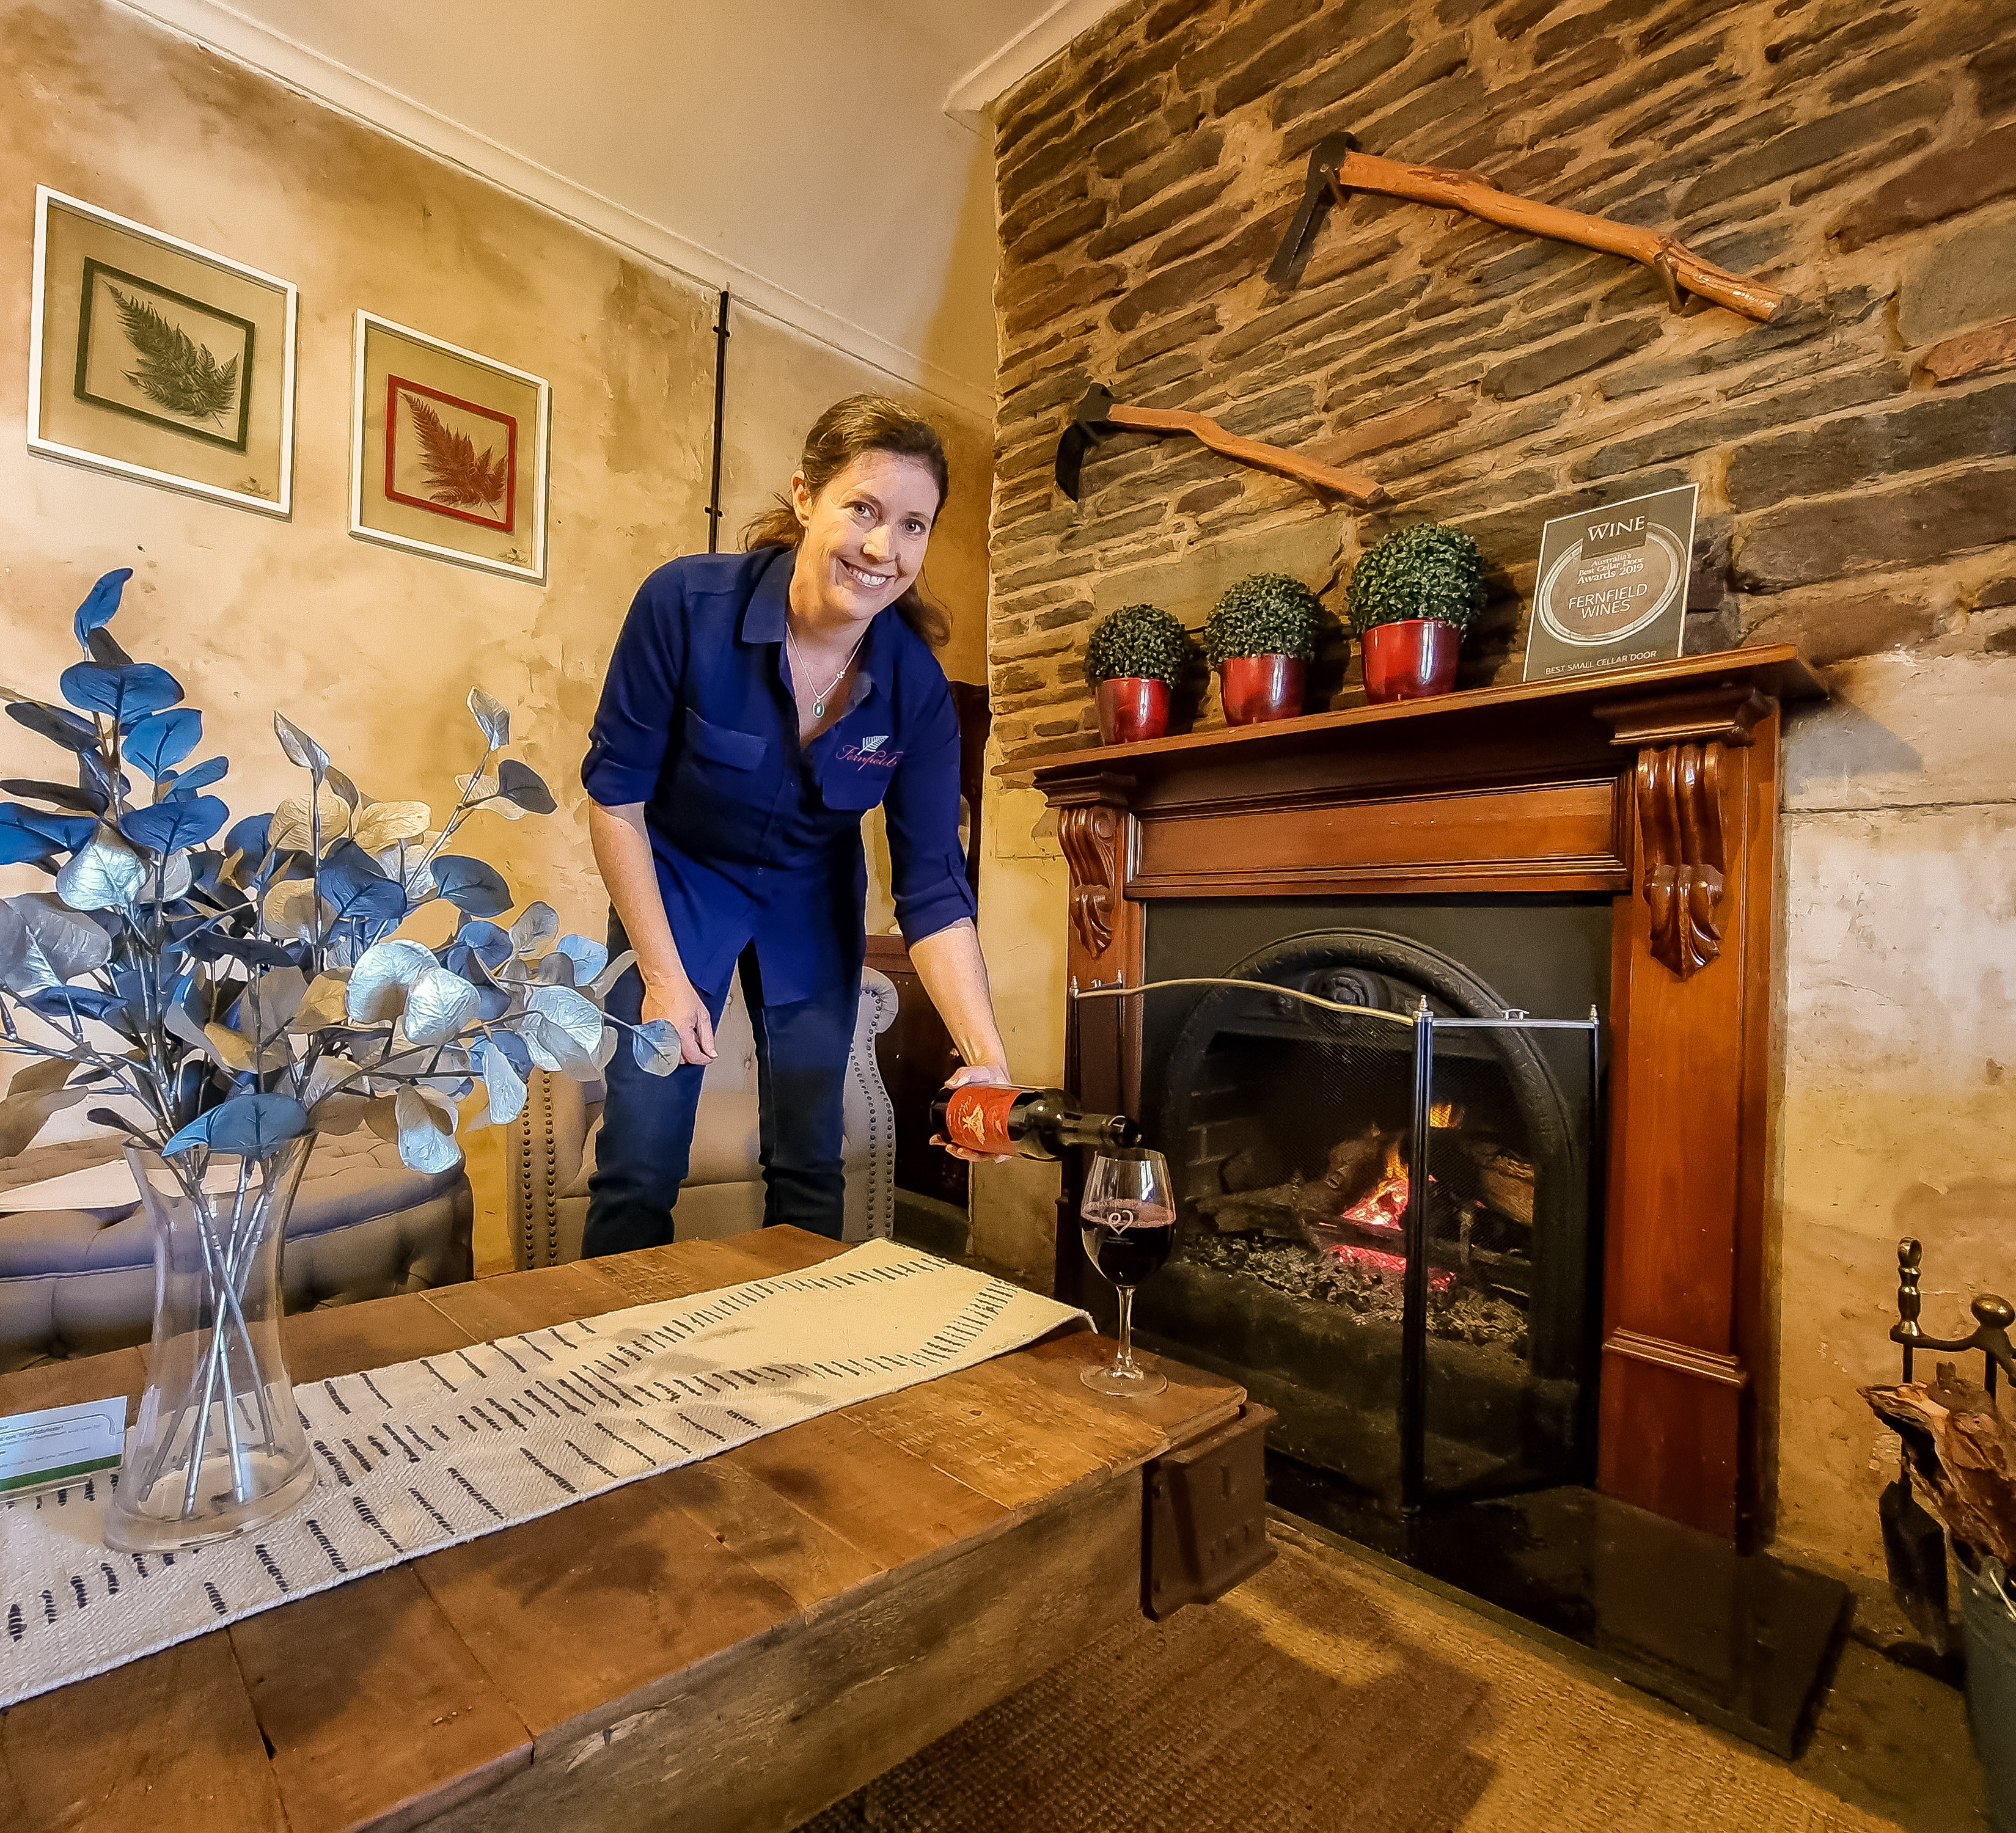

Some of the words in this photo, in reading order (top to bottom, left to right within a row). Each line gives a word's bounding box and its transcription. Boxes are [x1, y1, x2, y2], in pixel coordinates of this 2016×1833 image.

[1587, 515, 1645, 541] WINE
[1578, 567, 1594, 577] Best
[1597, 562, 1620, 573] Cellar
[1623, 557, 1644, 566] Door
[1591, 552, 1632, 567] Australia's
[1577, 570, 1616, 585] Awards
[1619, 563, 1644, 576] 2019
[1568, 584, 1648, 610] FERNFIELD
[1582, 599, 1630, 619] WINES
[1545, 664, 1566, 675] BEST
[1567, 661, 1593, 671] SMALL
[1596, 655, 1628, 667] CELLAR
[1630, 650, 1657, 662] DOOR
